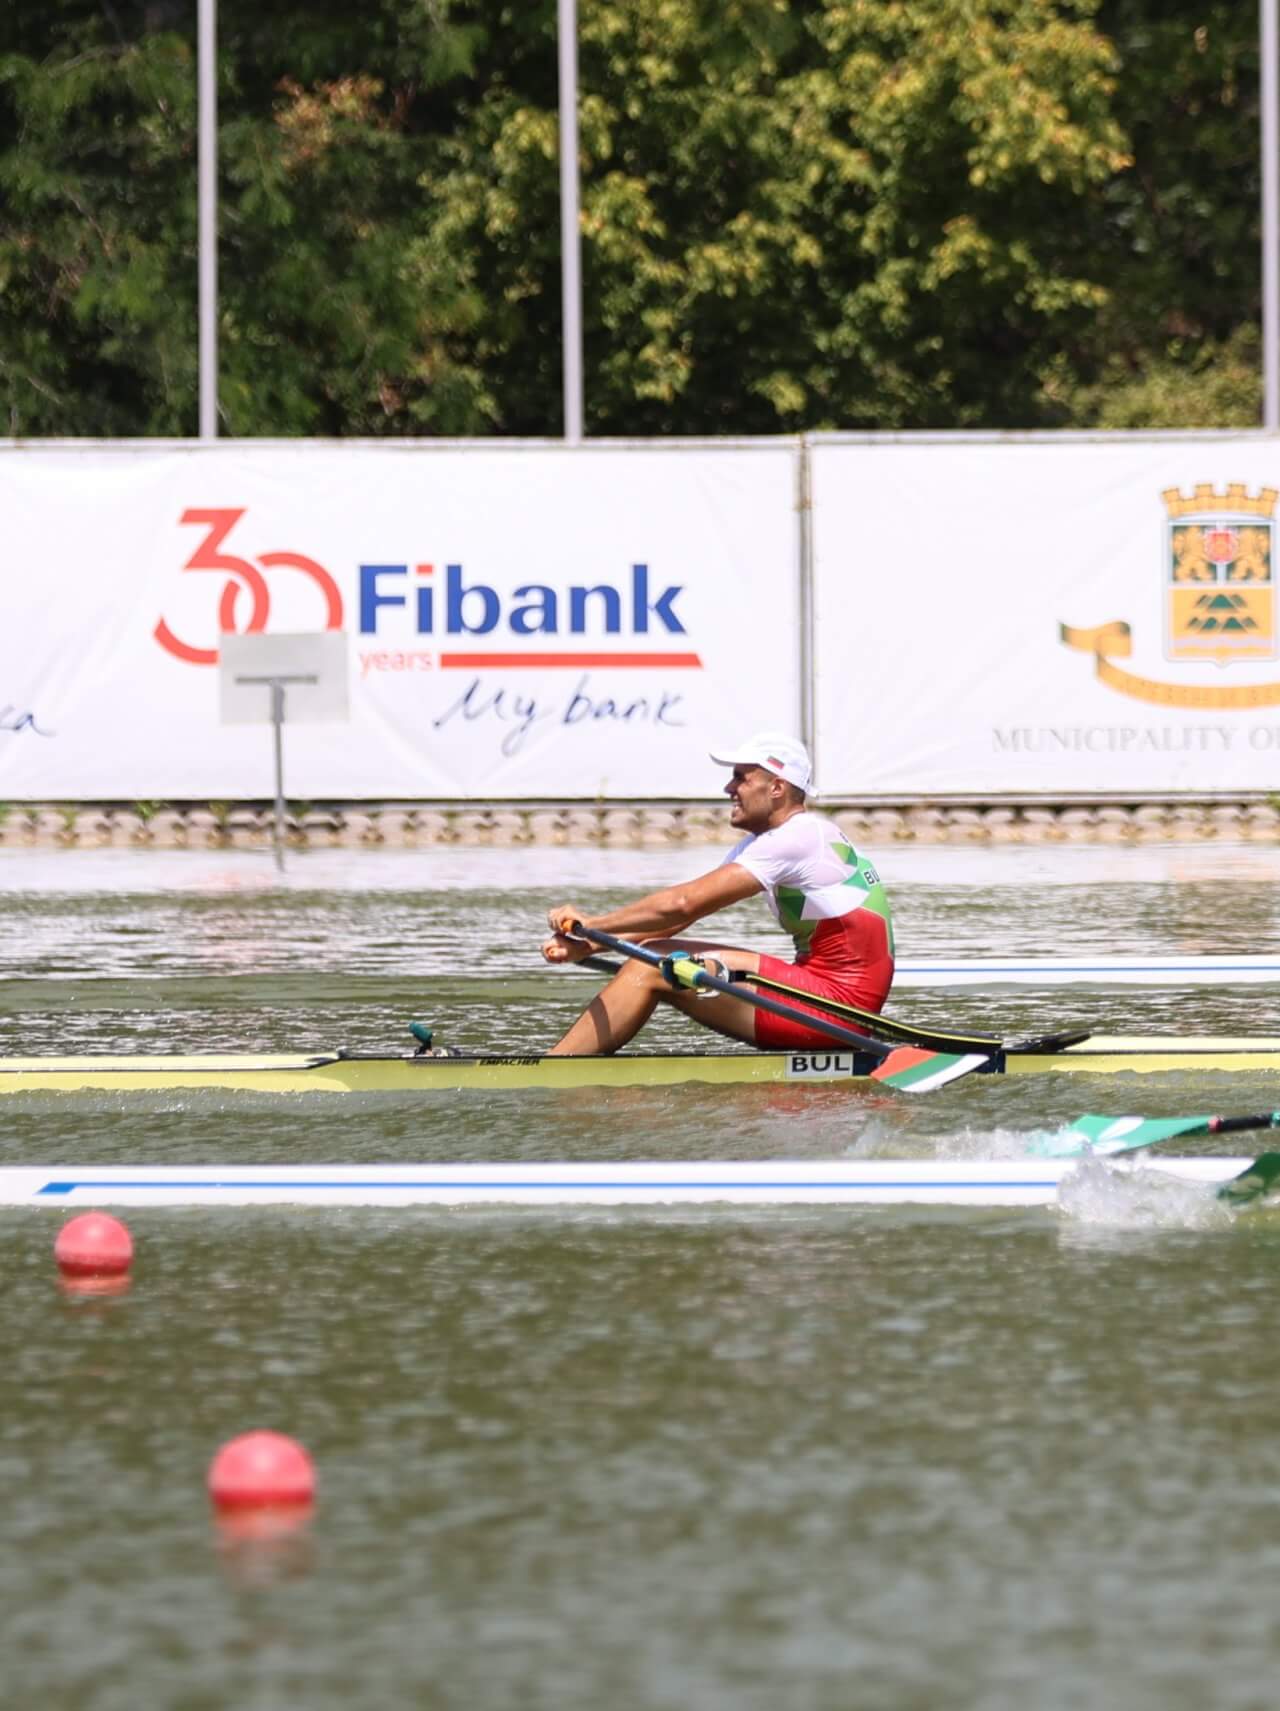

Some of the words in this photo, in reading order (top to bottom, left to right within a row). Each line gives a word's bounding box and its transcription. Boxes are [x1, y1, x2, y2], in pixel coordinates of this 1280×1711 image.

[358, 563, 687, 635] Fibank
[358, 651, 434, 678] years
[434, 678, 540, 757] My
[562, 673, 688, 727] bank
[992, 726, 1238, 752] MUNICIPALITY
[791, 1055, 850, 1073] BUL
